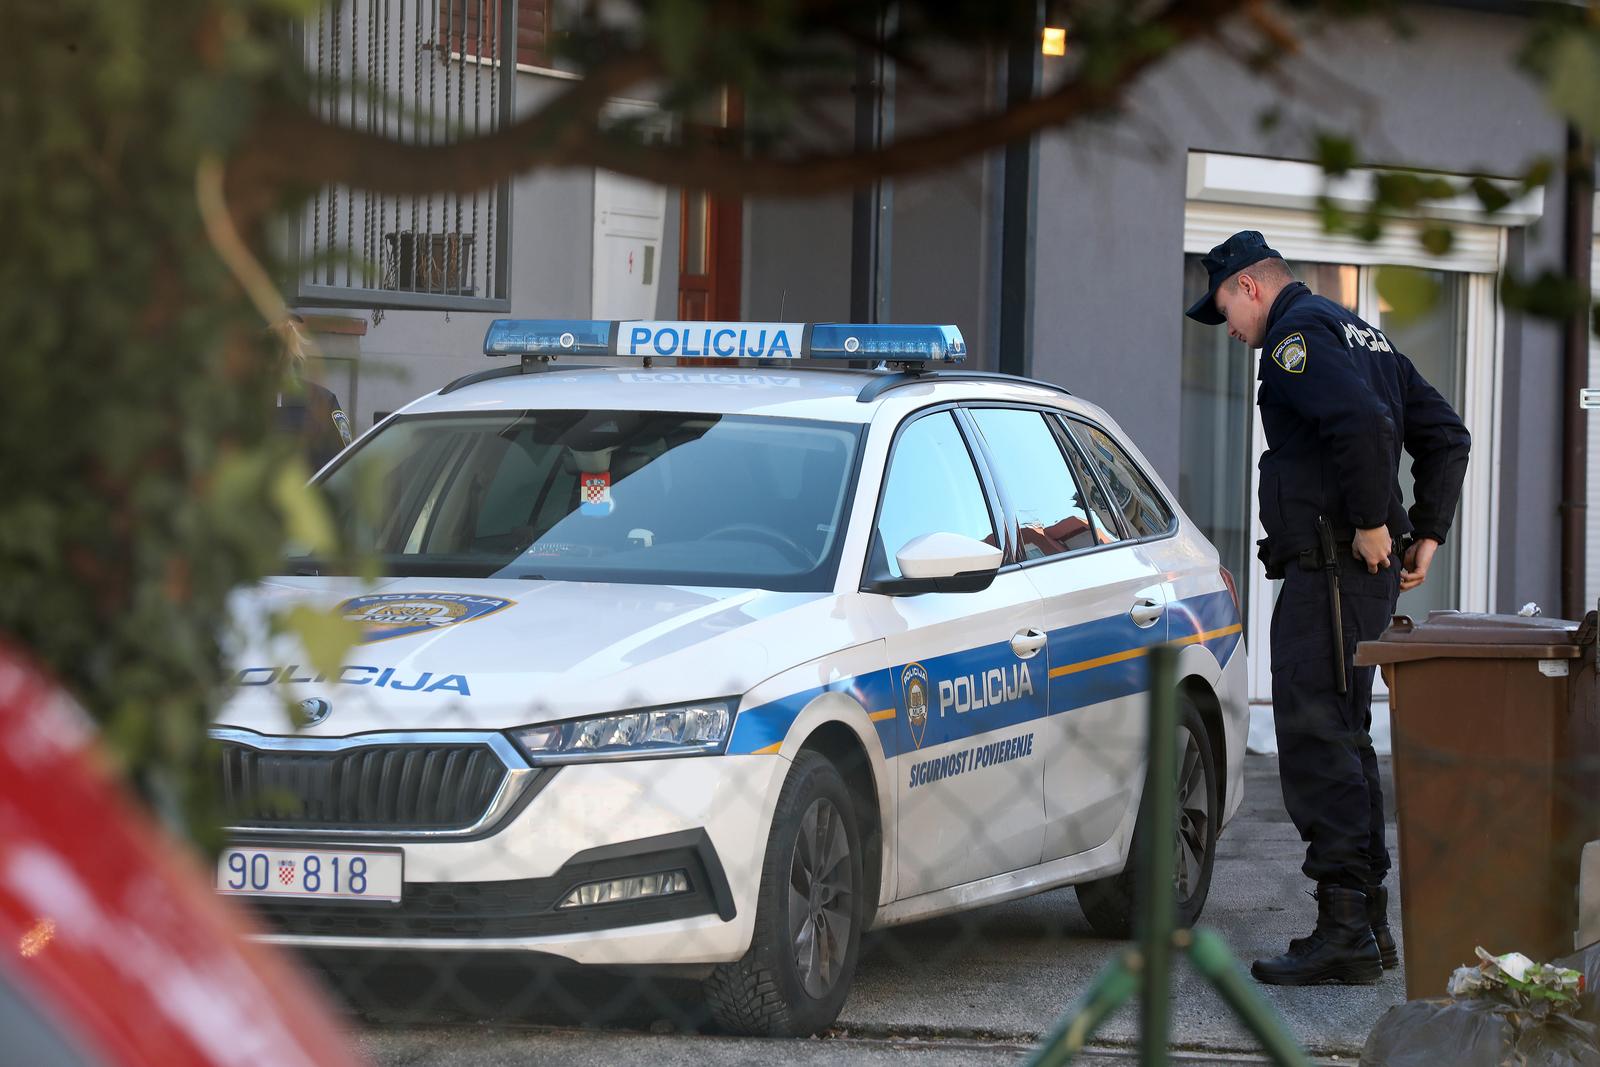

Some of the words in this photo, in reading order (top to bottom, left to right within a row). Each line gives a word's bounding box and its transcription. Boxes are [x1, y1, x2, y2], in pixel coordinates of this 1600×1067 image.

[629, 326, 793, 358] POLICIJA
[359, 593, 504, 608] POLICIJA
[364, 614, 432, 623] MUP
[903, 667, 928, 685] POLICIJA
[938, 661, 1034, 718] POLICIJA
[909, 750, 969, 789] SIGURNOST
[968, 749, 974, 772] I
[974, 732, 1034, 770] POVJERENJE
[228, 852, 270, 891] 90
[303, 855, 368, 895] 818
